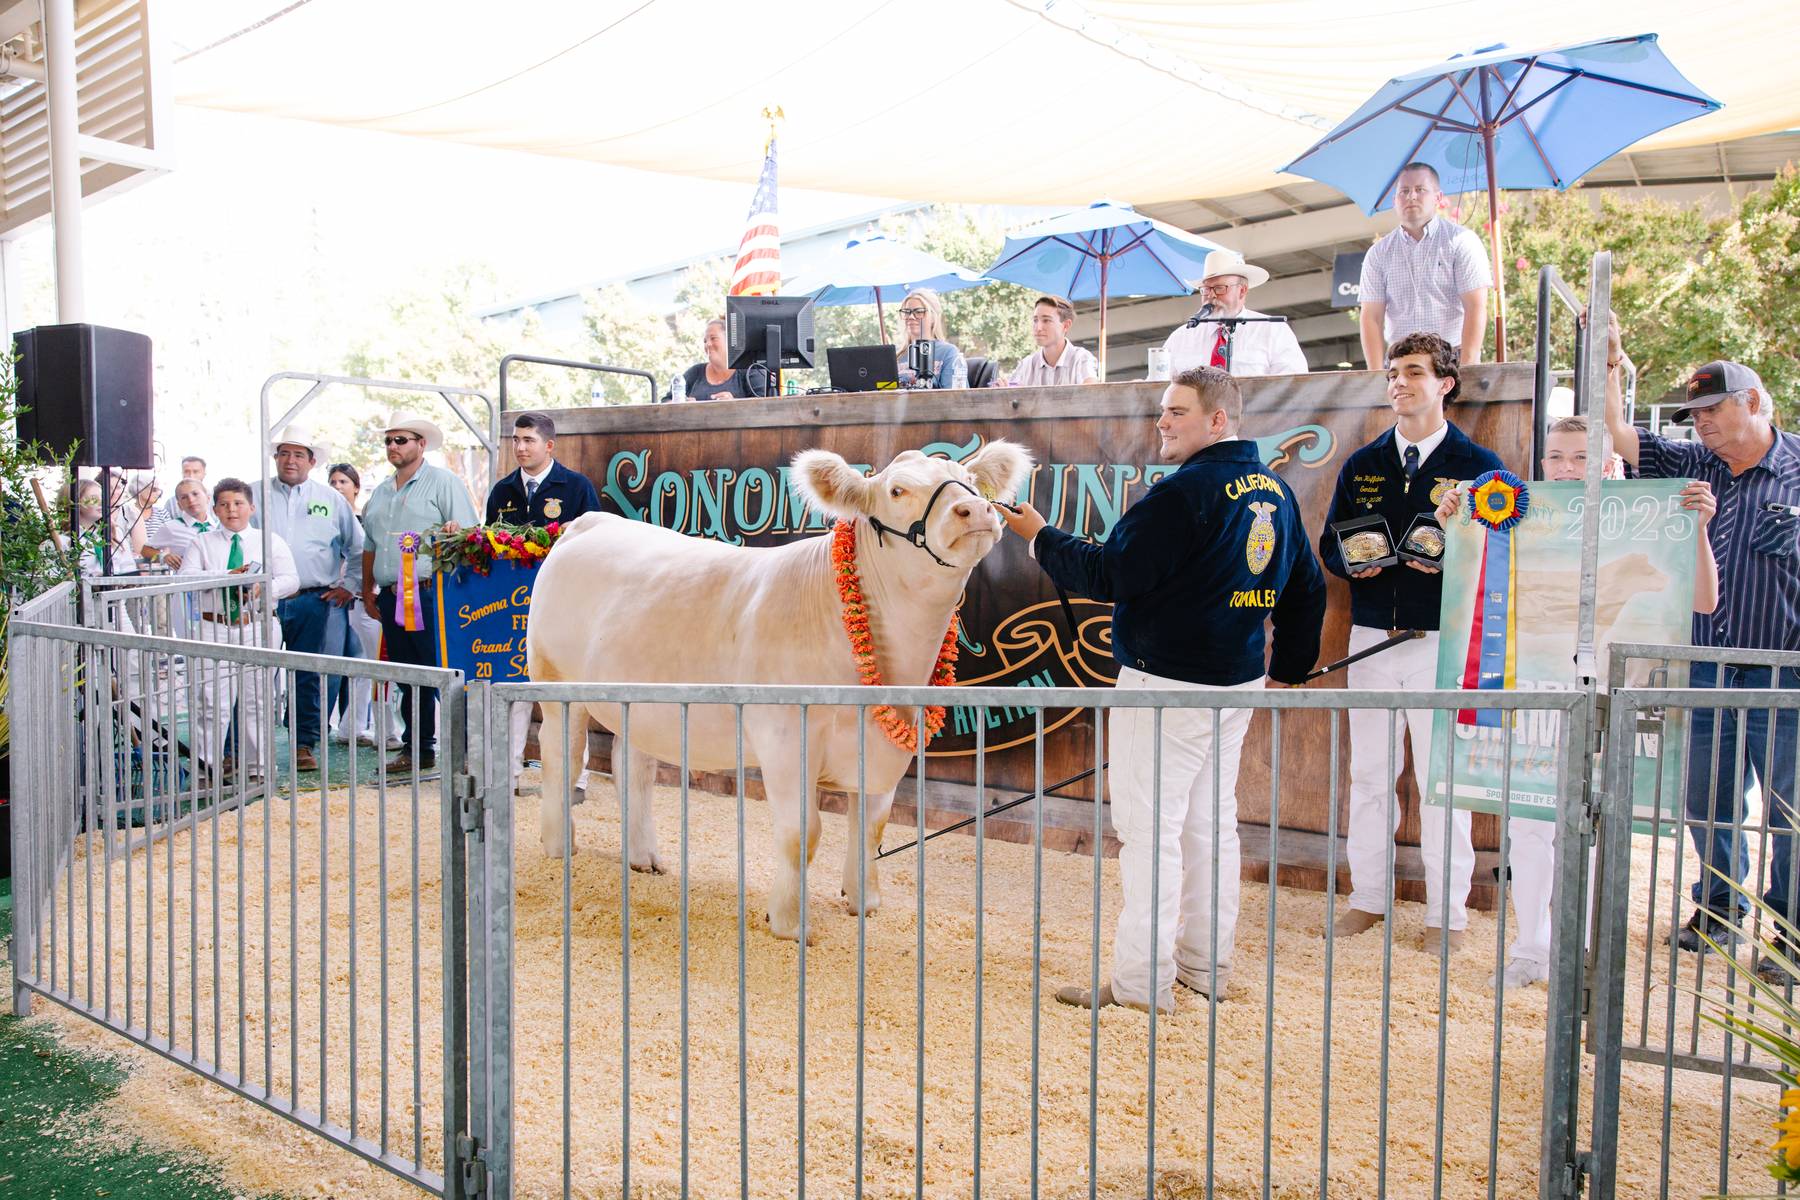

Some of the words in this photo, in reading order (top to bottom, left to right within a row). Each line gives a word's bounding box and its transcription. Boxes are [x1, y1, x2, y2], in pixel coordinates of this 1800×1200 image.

[601, 448, 878, 548] SONOM
[1566, 495, 1695, 541] 2025
[458, 598, 509, 629] Sonoma
[472, 637, 513, 654] Grand
[476, 662, 492, 678] 20
[1486, 789, 1531, 802] SPOORED
